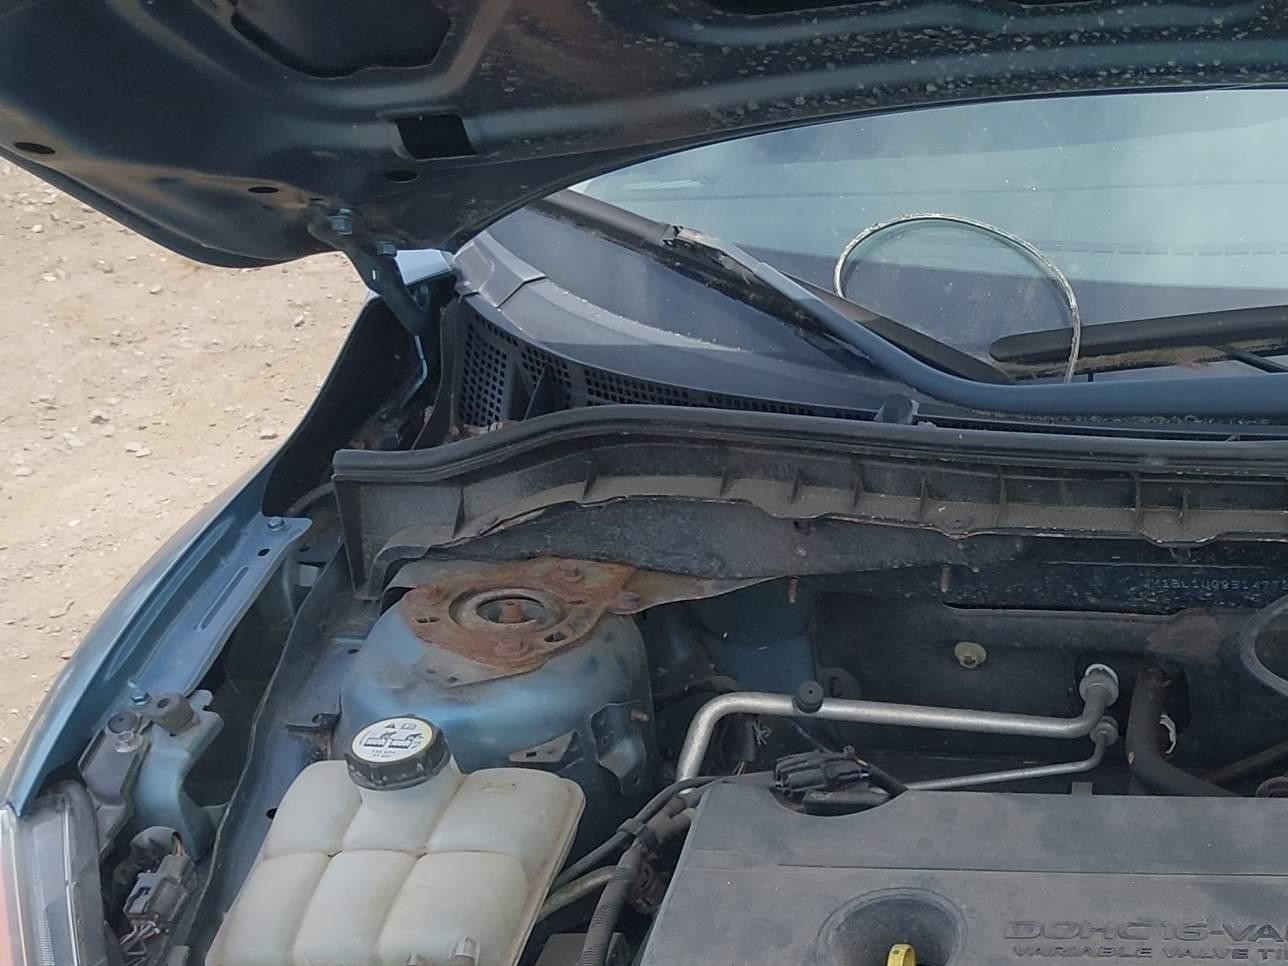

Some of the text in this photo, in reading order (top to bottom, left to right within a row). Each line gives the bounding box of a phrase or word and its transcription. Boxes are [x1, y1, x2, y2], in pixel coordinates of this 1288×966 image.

[1003, 920, 1152, 940] DOHC
[1012, 945, 1153, 959] VARIABLE
[1161, 947, 1250, 960] VALVE
